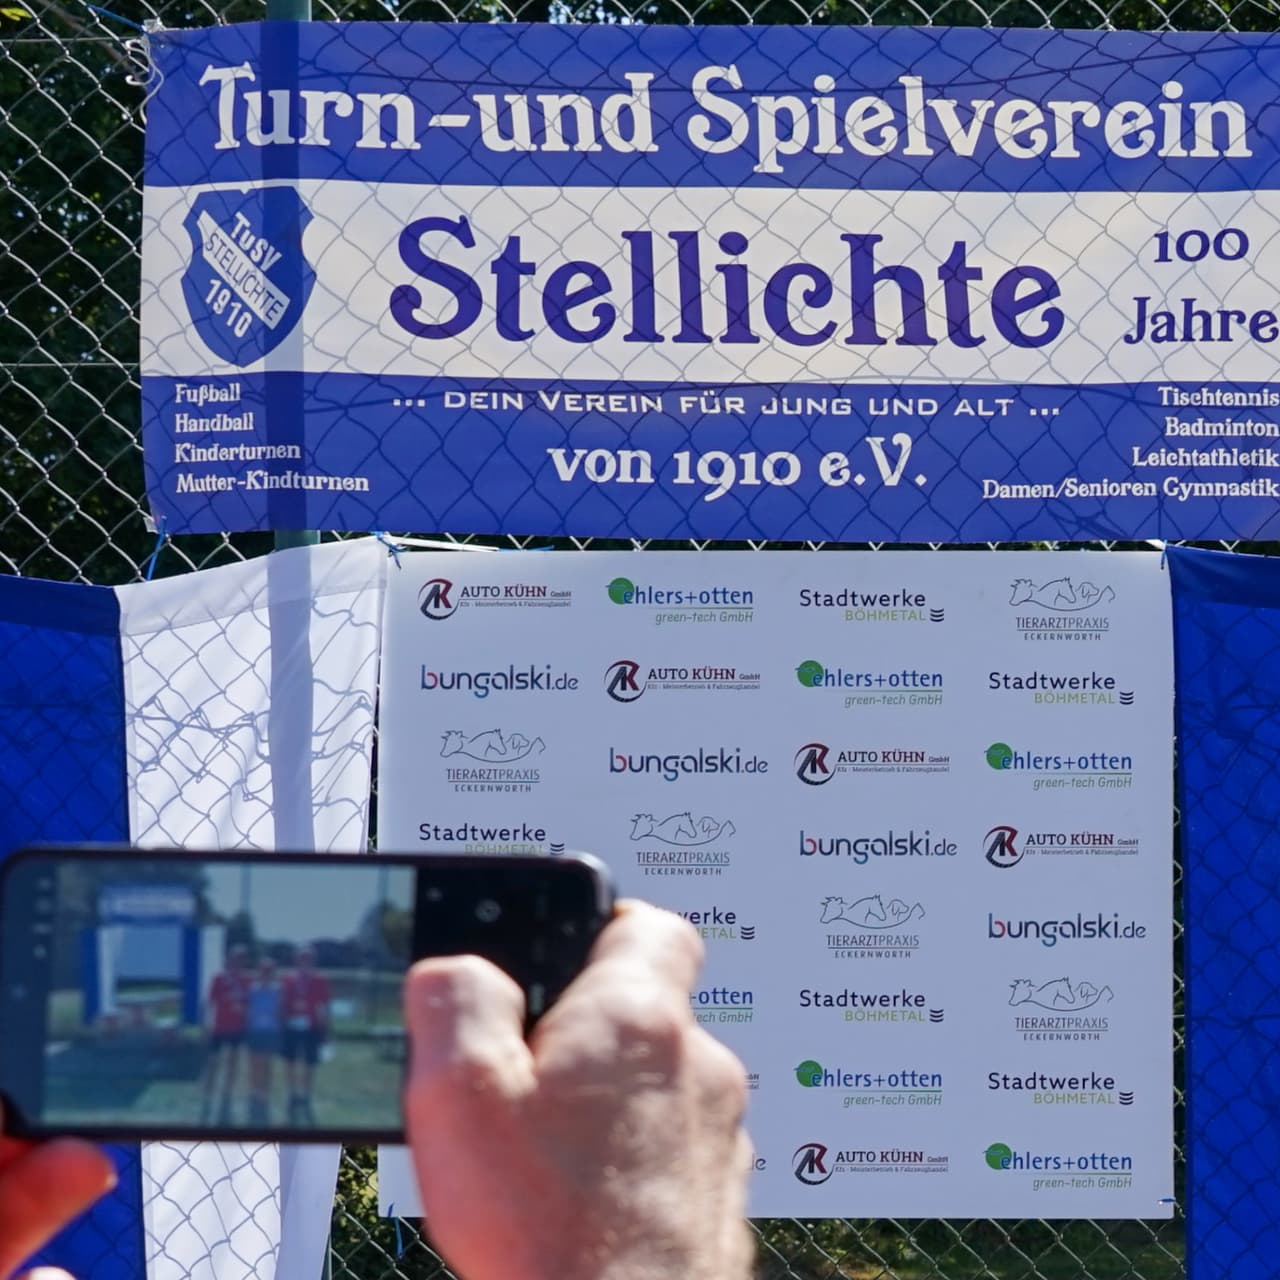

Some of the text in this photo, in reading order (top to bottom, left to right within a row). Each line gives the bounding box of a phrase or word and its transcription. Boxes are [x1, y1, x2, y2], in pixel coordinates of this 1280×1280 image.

[199, 62, 1253, 174] Turn-und Spielverein
[229, 211, 283, 273] TuSV
[1152, 228, 1250, 263] 100
[205, 232, 285, 322] STELLICHTE
[388, 214, 1066, 349] Stellichte
[204, 279, 253, 338] 1910
[1123, 295, 1280, 346] Jahre
[174, 383, 242, 405] Fußball
[1157, 386, 1280, 407] Tischtennis
[536, 391, 664, 414] VEREIN
[679, 390, 746, 415] FÜR
[761, 397, 853, 417] JUNG
[869, 397, 940, 417] UND
[954, 397, 1014, 417] ALT
[174, 412, 255, 434] Handball
[1164, 416, 1280, 437] Badminton
[174, 442, 302, 462] Kinderturnen
[1131, 446, 1280, 469] Leichtathletik
[546, 432, 927, 502] von 1910 e.V.
[175, 470, 370, 494] Mutter-Kindturnen
[981, 477, 1280, 502] Damen/Senioren Gymnastik
[460, 586, 500, 598] AUTO
[504, 584, 547, 597] KÜHN
[623, 586, 753, 605] ehlers+otten
[800, 589, 926, 607] Stadtwerke
[655, 611, 753, 625] green-tech GmbH
[845, 607, 926, 622] BÖHMETAL
[1016, 617, 1109, 629] TIERARZTPRAXIS
[1024, 632, 1101, 640] ECKERNWORTH
[421, 664, 579, 698] bungalski.de
[647, 668, 687, 680] AUTO
[691, 667, 734, 680] KÜHN
[812, 669, 943, 688] ehlers+otten
[989, 672, 1115, 689] Stadtwerke
[845, 694, 943, 708] green-tech GmbH
[1034, 690, 1115, 704] BÖHMETAL
[610, 748, 767, 782] bungalski.de
[837, 751, 876, 763] AUTO
[881, 749, 923, 762] KÜHN
[1001, 751, 1131, 770] ehlers+otten
[447, 768, 540, 781] TIERARZTPRAXIS
[1034, 777, 1132, 790] green-tech GmbH
[455, 784, 532, 792] ECKERNWORTH
[419, 824, 546, 841] Stadtwerke
[1026, 833, 1066, 845] AUTO
[1070, 832, 1113, 845] KÜHN
[800, 830, 958, 864] bungalski.de
[637, 852, 730, 864] TIERARZTPRAXIS
[644, 868, 721, 876] ECKERNWORTH
[989, 913, 1146, 947] bungalski.de
[826, 934, 919, 947] TIERARZTPRAXIS
[834, 950, 911, 958] ECKERNWORTH
[800, 990, 926, 1007] Stadtwerke
[845, 1008, 926, 1022] BÖHMETAL
[1015, 1017, 1108, 1029] TIERARZTPRAXIS
[1023, 1033, 1100, 1041] ECKERNWORTH
[812, 1069, 942, 1088] ehlers+otten
[989, 1072, 1115, 1090] Stadtwerke
[844, 1094, 942, 1108] green-tech GmbH
[1033, 1090, 1115, 1105] BÖHMETAL
[834, 1151, 874, 1163] AUTO
[878, 1149, 921, 1162] KÜHN
[1001, 1151, 1131, 1171] ehlers+otten
[1034, 1177, 1132, 1190] green-tech GmbH
